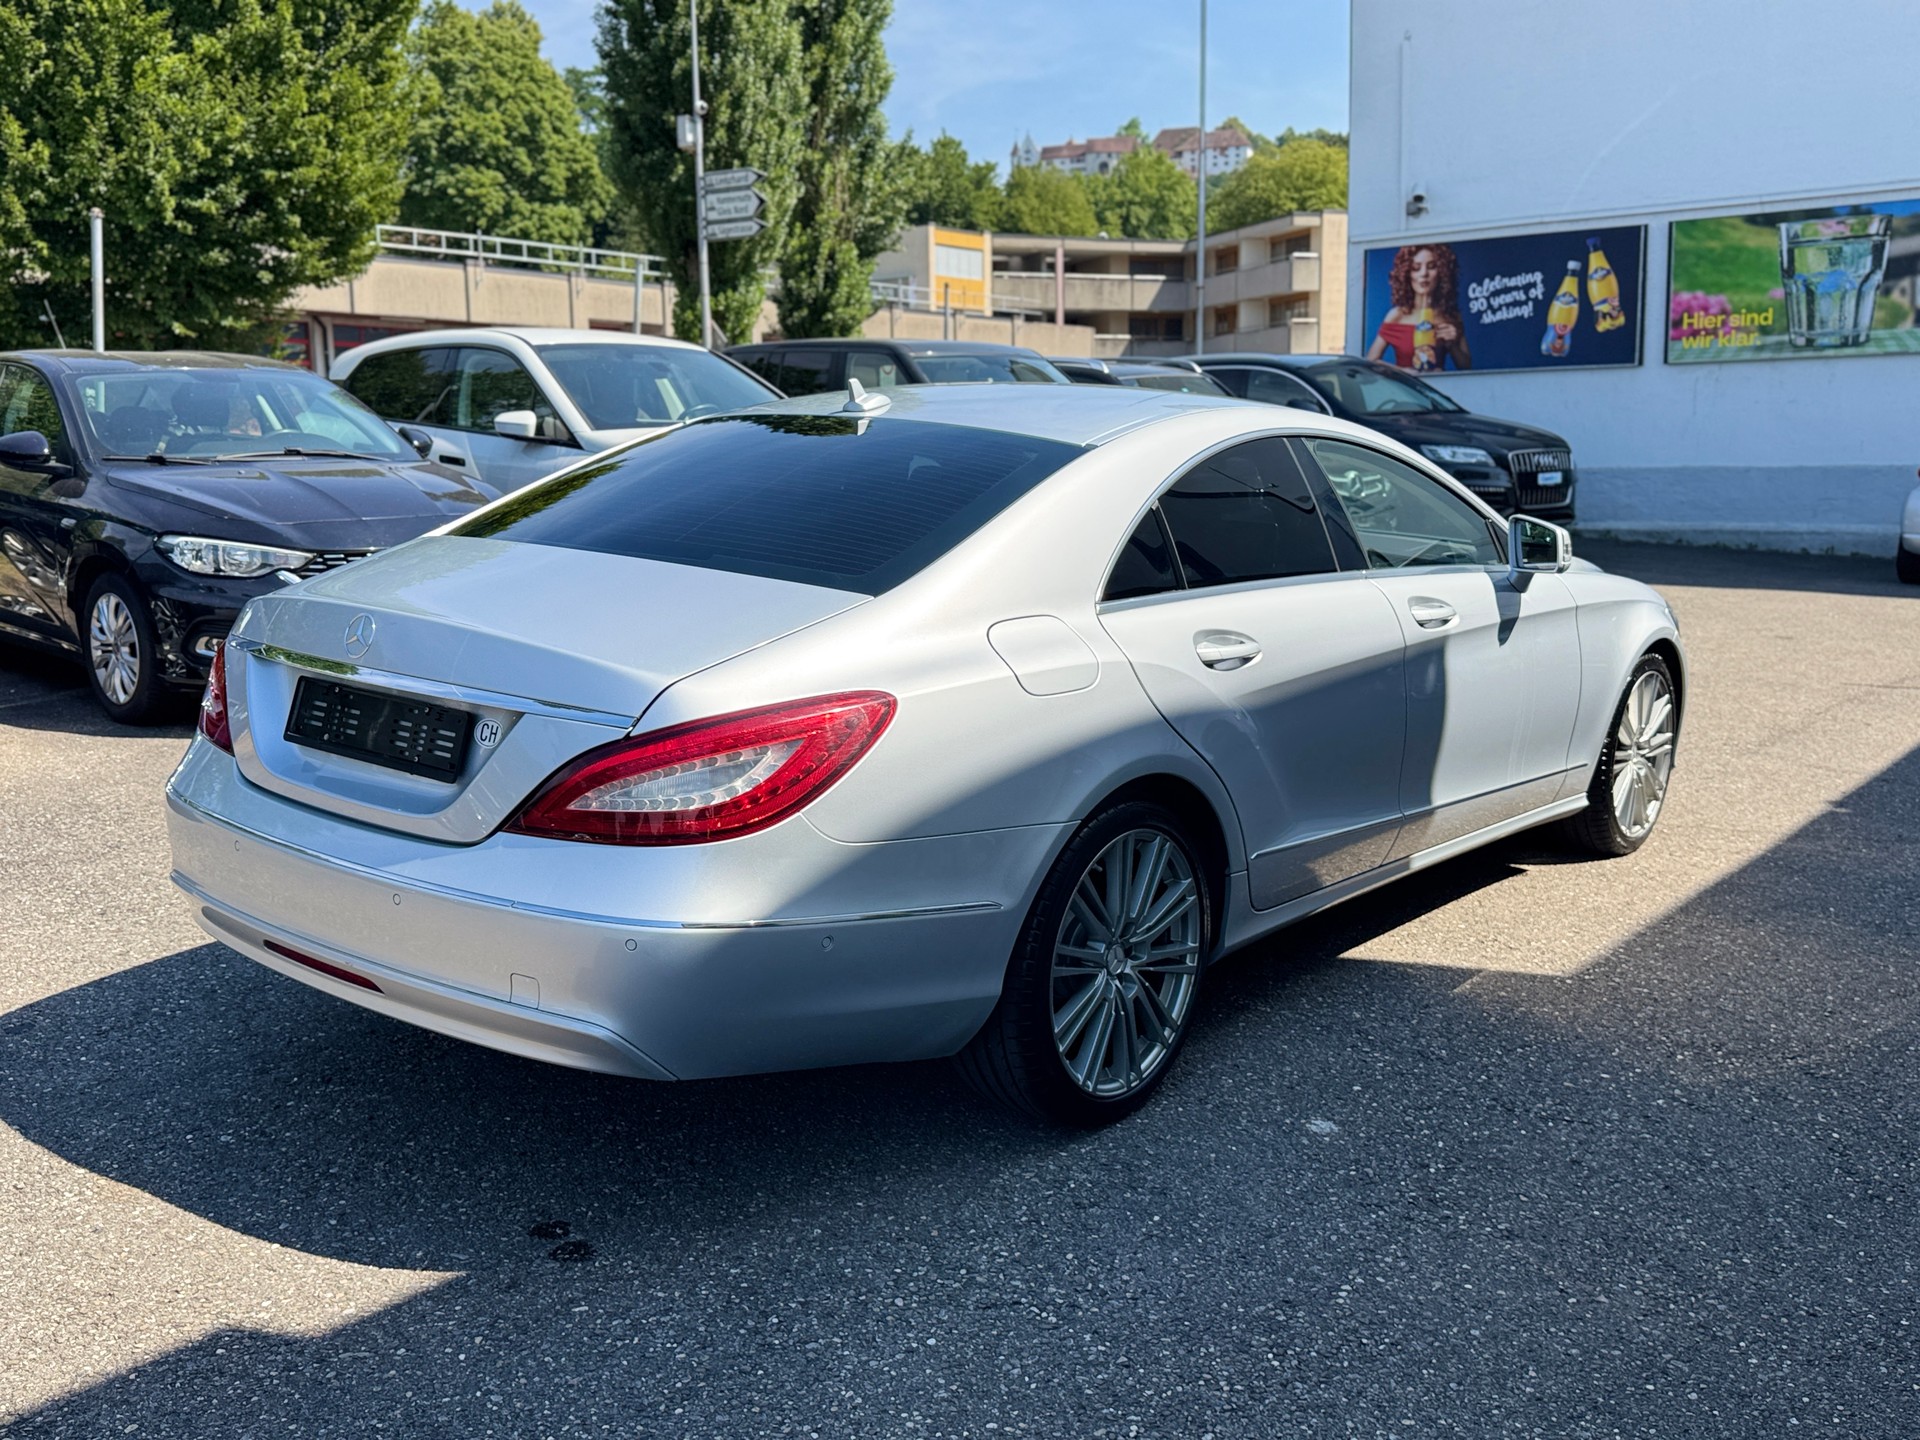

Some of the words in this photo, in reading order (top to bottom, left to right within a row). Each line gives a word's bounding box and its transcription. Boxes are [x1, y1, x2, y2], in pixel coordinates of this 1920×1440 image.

[1467, 271, 1544, 299] Celebrating
[1469, 297, 1488, 314] 90
[1489, 289, 1527, 310] years
[1528, 283, 1546, 300] of
[1480, 300, 1534, 325] shaking!
[1682, 311, 1726, 331] Hier
[1729, 307, 1774, 328] sind
[1681, 330, 1715, 350] wir
[1717, 328, 1762, 348] klar.
[480, 722, 499, 744] CH
